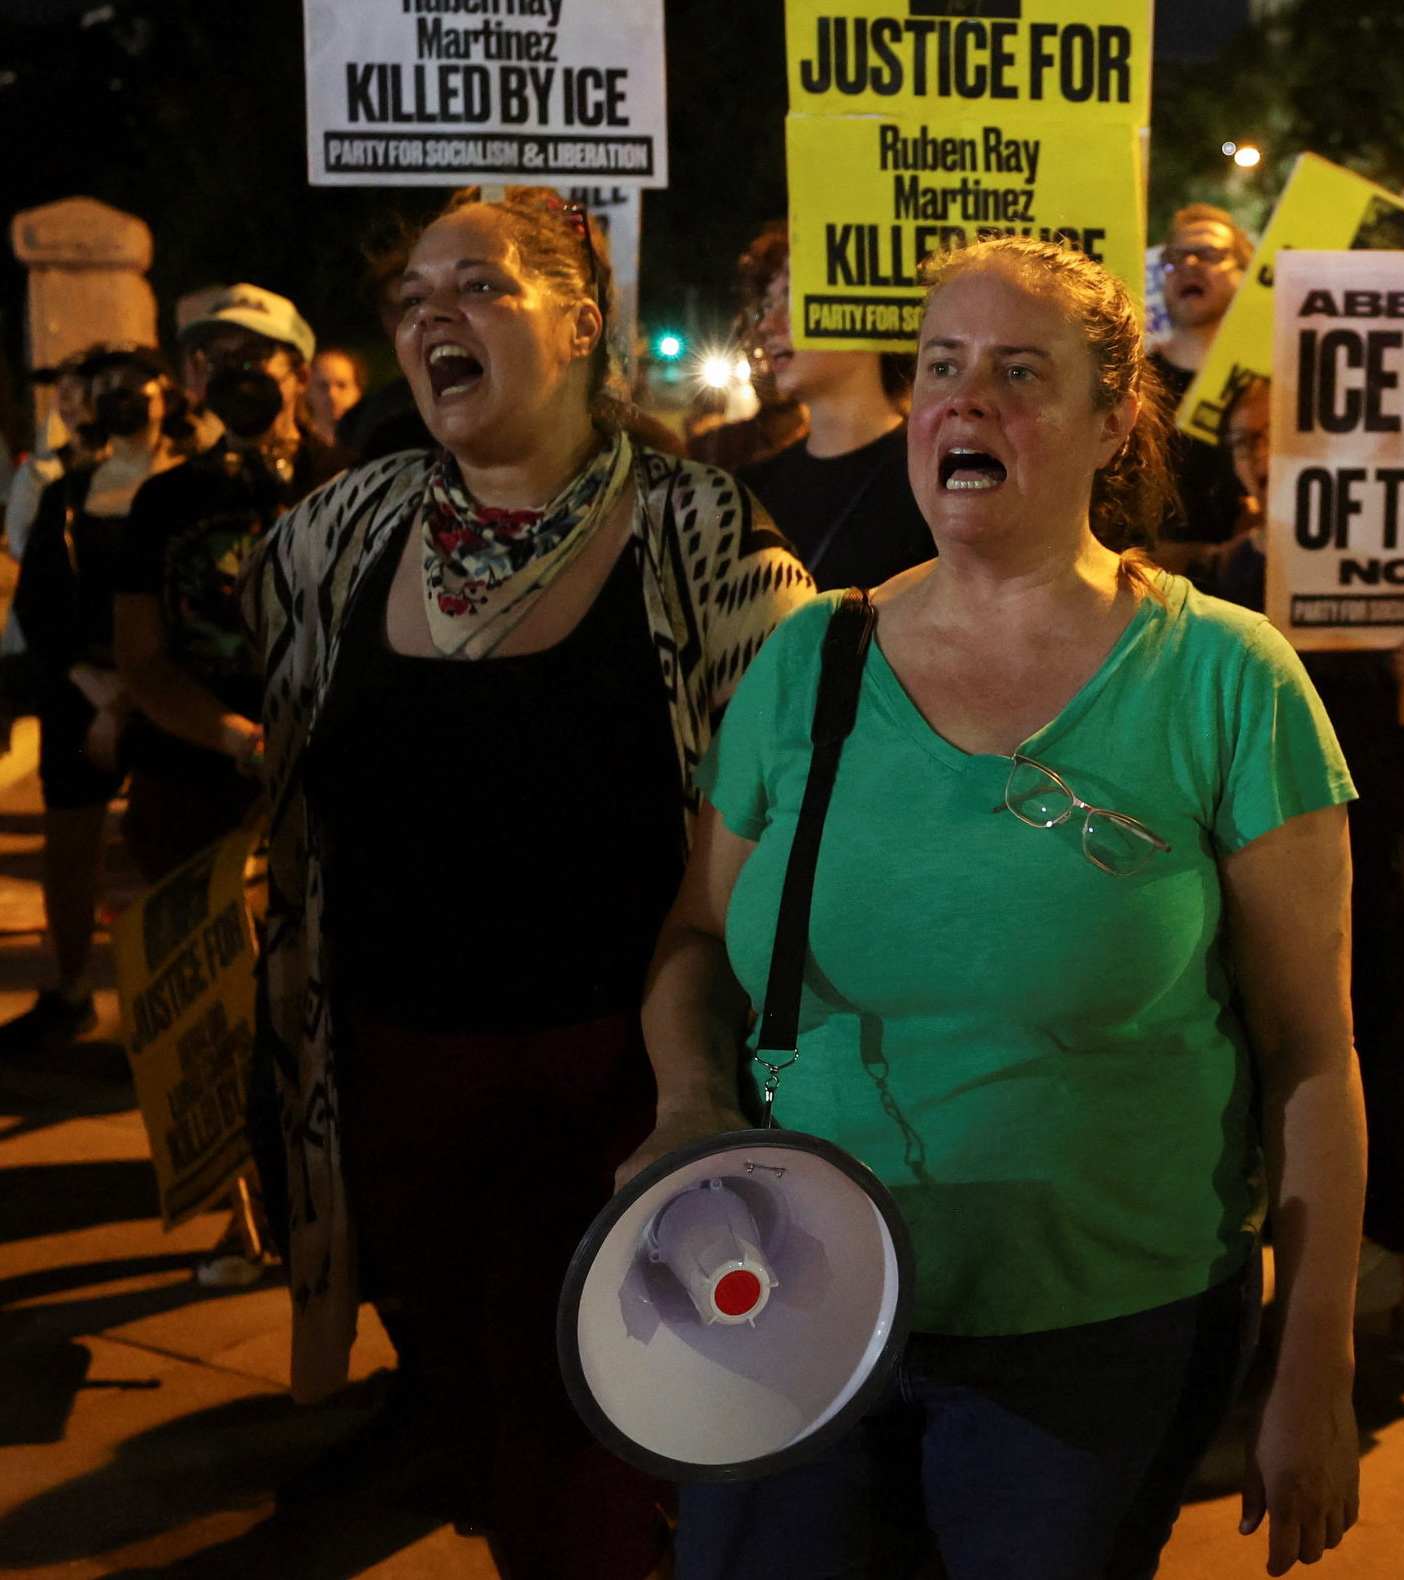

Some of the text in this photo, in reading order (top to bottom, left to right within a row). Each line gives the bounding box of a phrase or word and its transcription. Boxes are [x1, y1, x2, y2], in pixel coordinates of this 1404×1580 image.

[417, 17, 558, 62] Martinez
[800, 16, 1131, 103] JUSTICE FOR
[346, 62, 629, 126] KILLED BY ICE
[329, 140, 648, 169] PARTY FOR SOCIALISM & LIBERATION
[879, 124, 1041, 184] Ruben Ray
[894, 175, 1036, 222] Martinez
[808, 302, 864, 330] PARTY
[866, 303, 900, 331] FOR
[1297, 329, 1403, 434] ICE
[1295, 466, 1367, 550] OF
